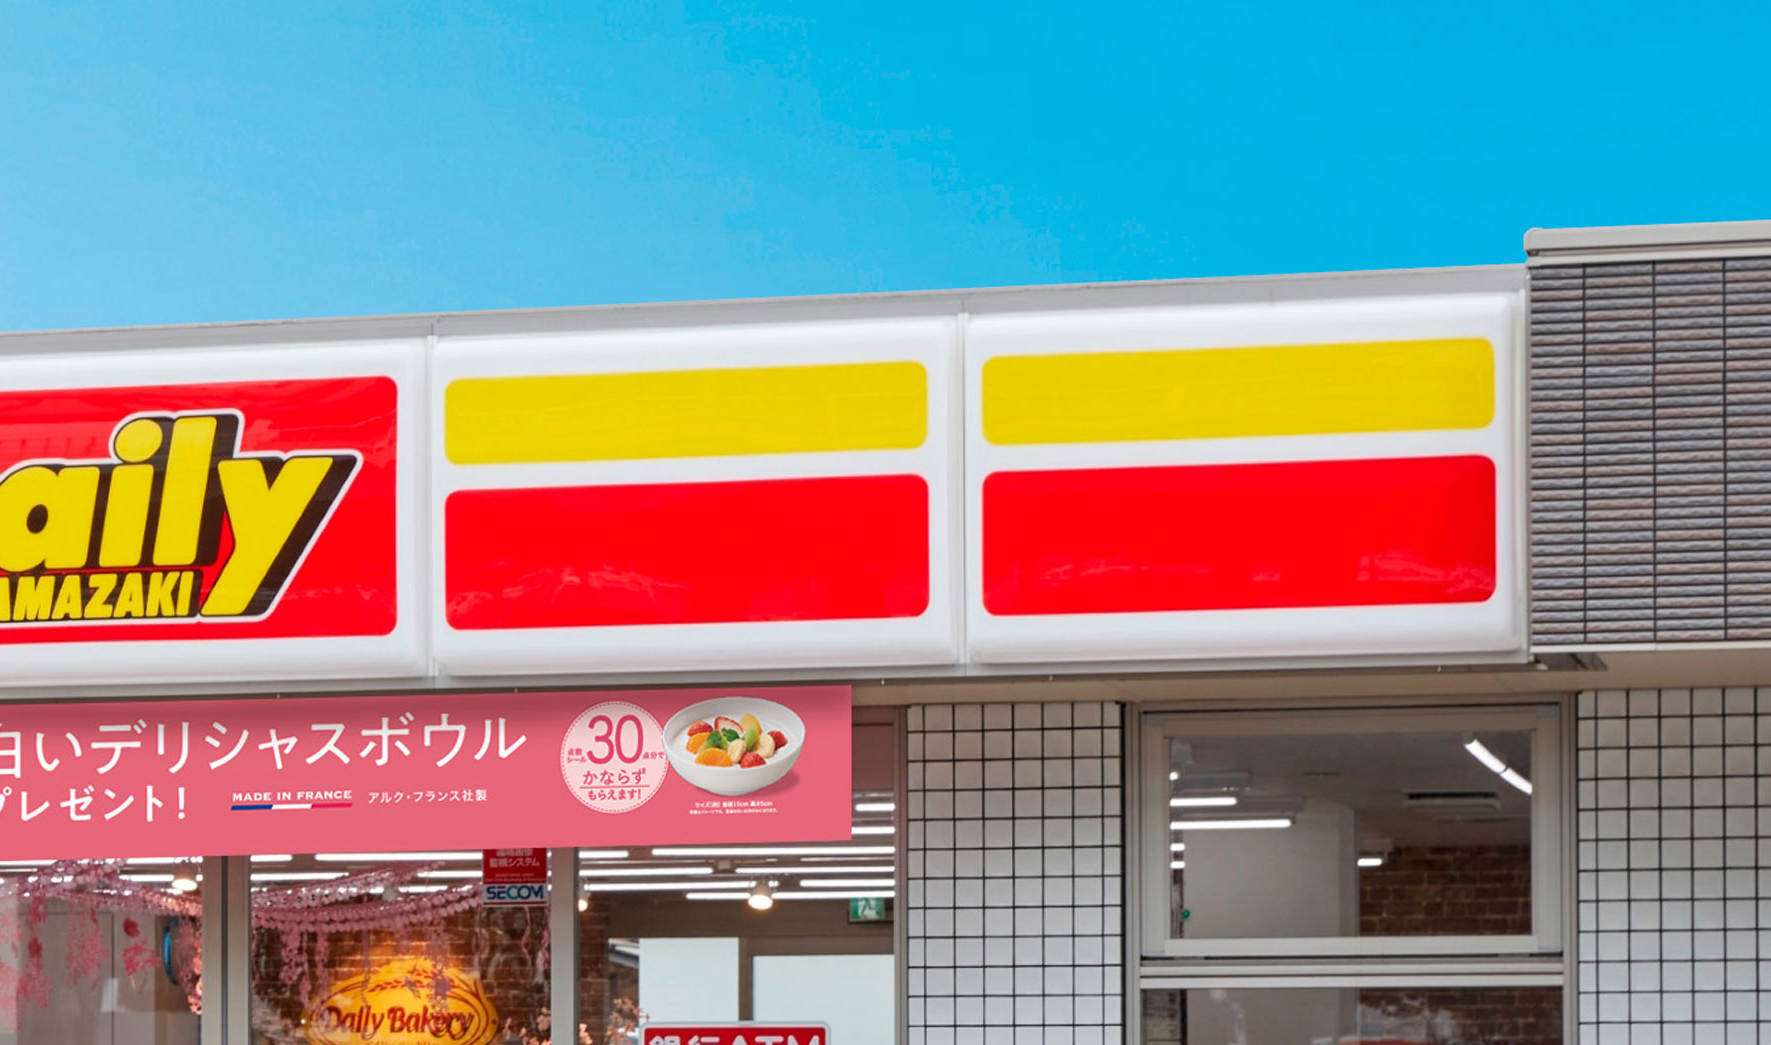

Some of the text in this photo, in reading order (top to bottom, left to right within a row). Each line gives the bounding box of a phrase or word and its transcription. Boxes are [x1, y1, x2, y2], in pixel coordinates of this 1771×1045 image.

[586, 714, 644, 765] 30
[583, 768, 647, 786] かならず
[232, 790, 353, 802] MADE IN FRANCE
[486, 885, 544, 900] SECOM
[325, 1005, 474, 1039] Daily Bakery
